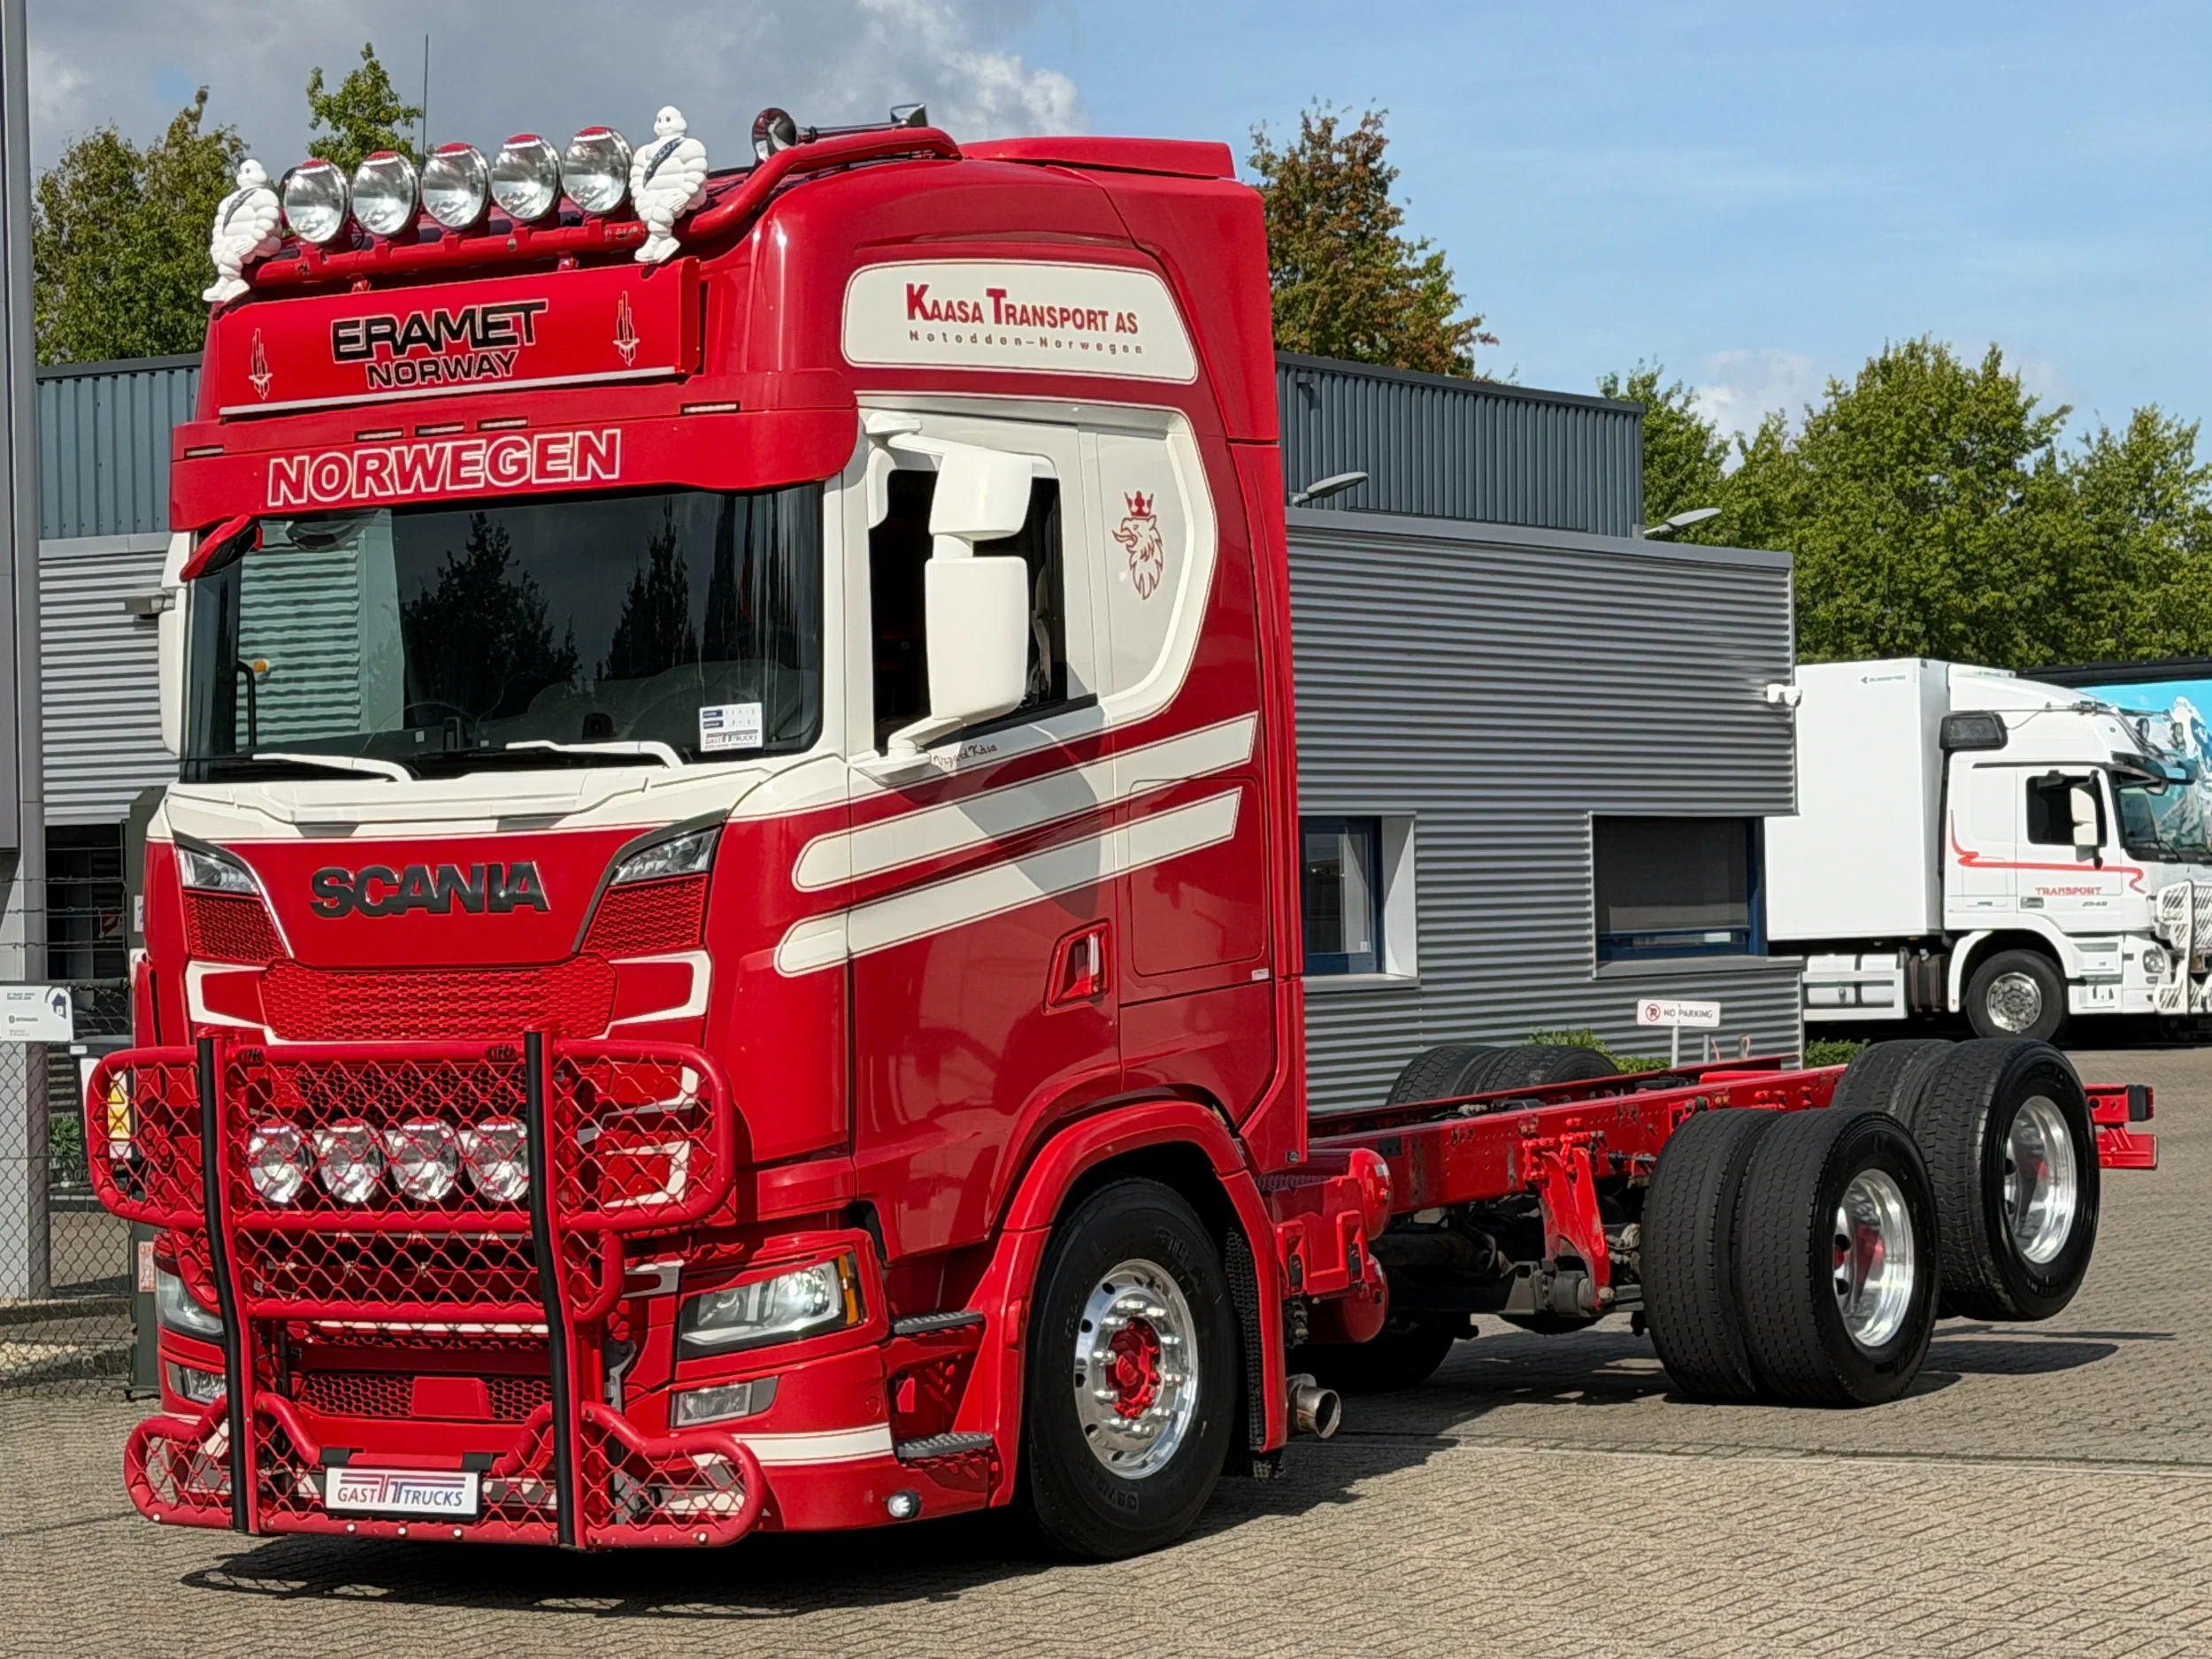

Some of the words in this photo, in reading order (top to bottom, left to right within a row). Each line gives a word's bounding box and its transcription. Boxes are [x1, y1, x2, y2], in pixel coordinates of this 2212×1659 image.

[331, 298, 549, 363] ERAMET
[906, 283, 984, 324] KAASA
[986, 288, 1110, 332] TRANSPORT
[1115, 311, 1139, 334] AS
[365, 350, 518, 389] NORWAY
[267, 428, 621, 507] NORWEGEN
[311, 861, 551, 918] SCANIA
[2035, 887, 2102, 896] TRANSPORT
[1663, 1009, 1676, 1018] NO
[1678, 1009, 1713, 1019] PARKING
[337, 1486, 378, 1504] GAST
[403, 1489, 464, 1508] TRUCKS
